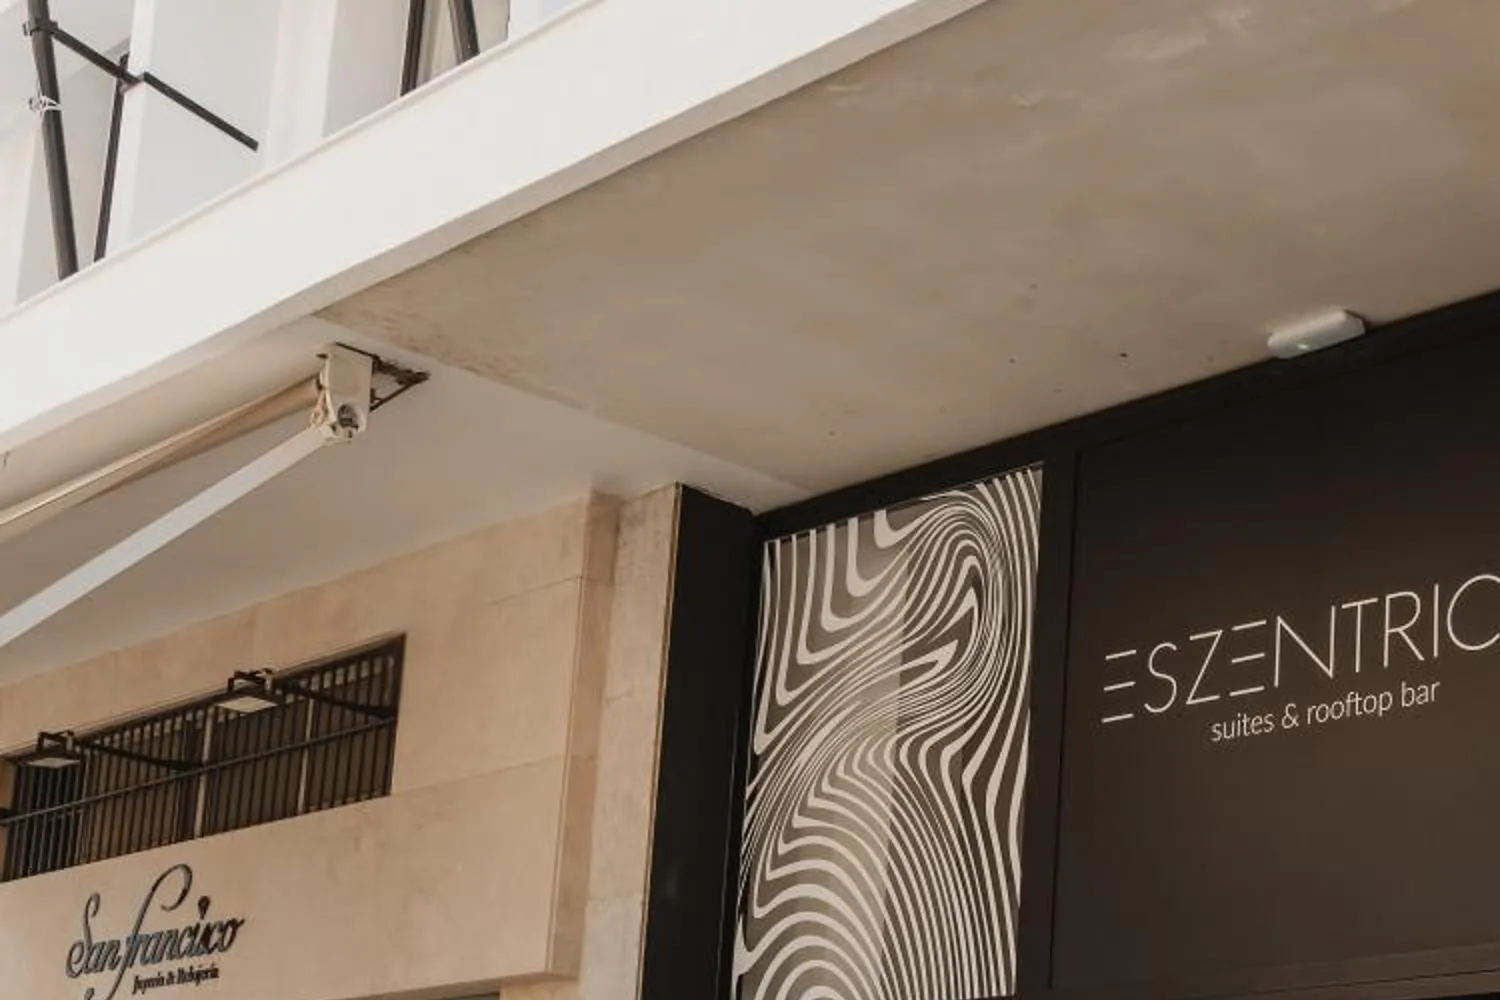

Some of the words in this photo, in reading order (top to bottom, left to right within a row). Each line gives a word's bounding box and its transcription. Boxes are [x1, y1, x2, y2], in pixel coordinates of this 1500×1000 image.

[1210, 711, 1275, 742] suites
[1281, 703, 1300, 729] &
[1307, 690, 1394, 726] rooftop
[1401, 680, 1441, 708] bar
